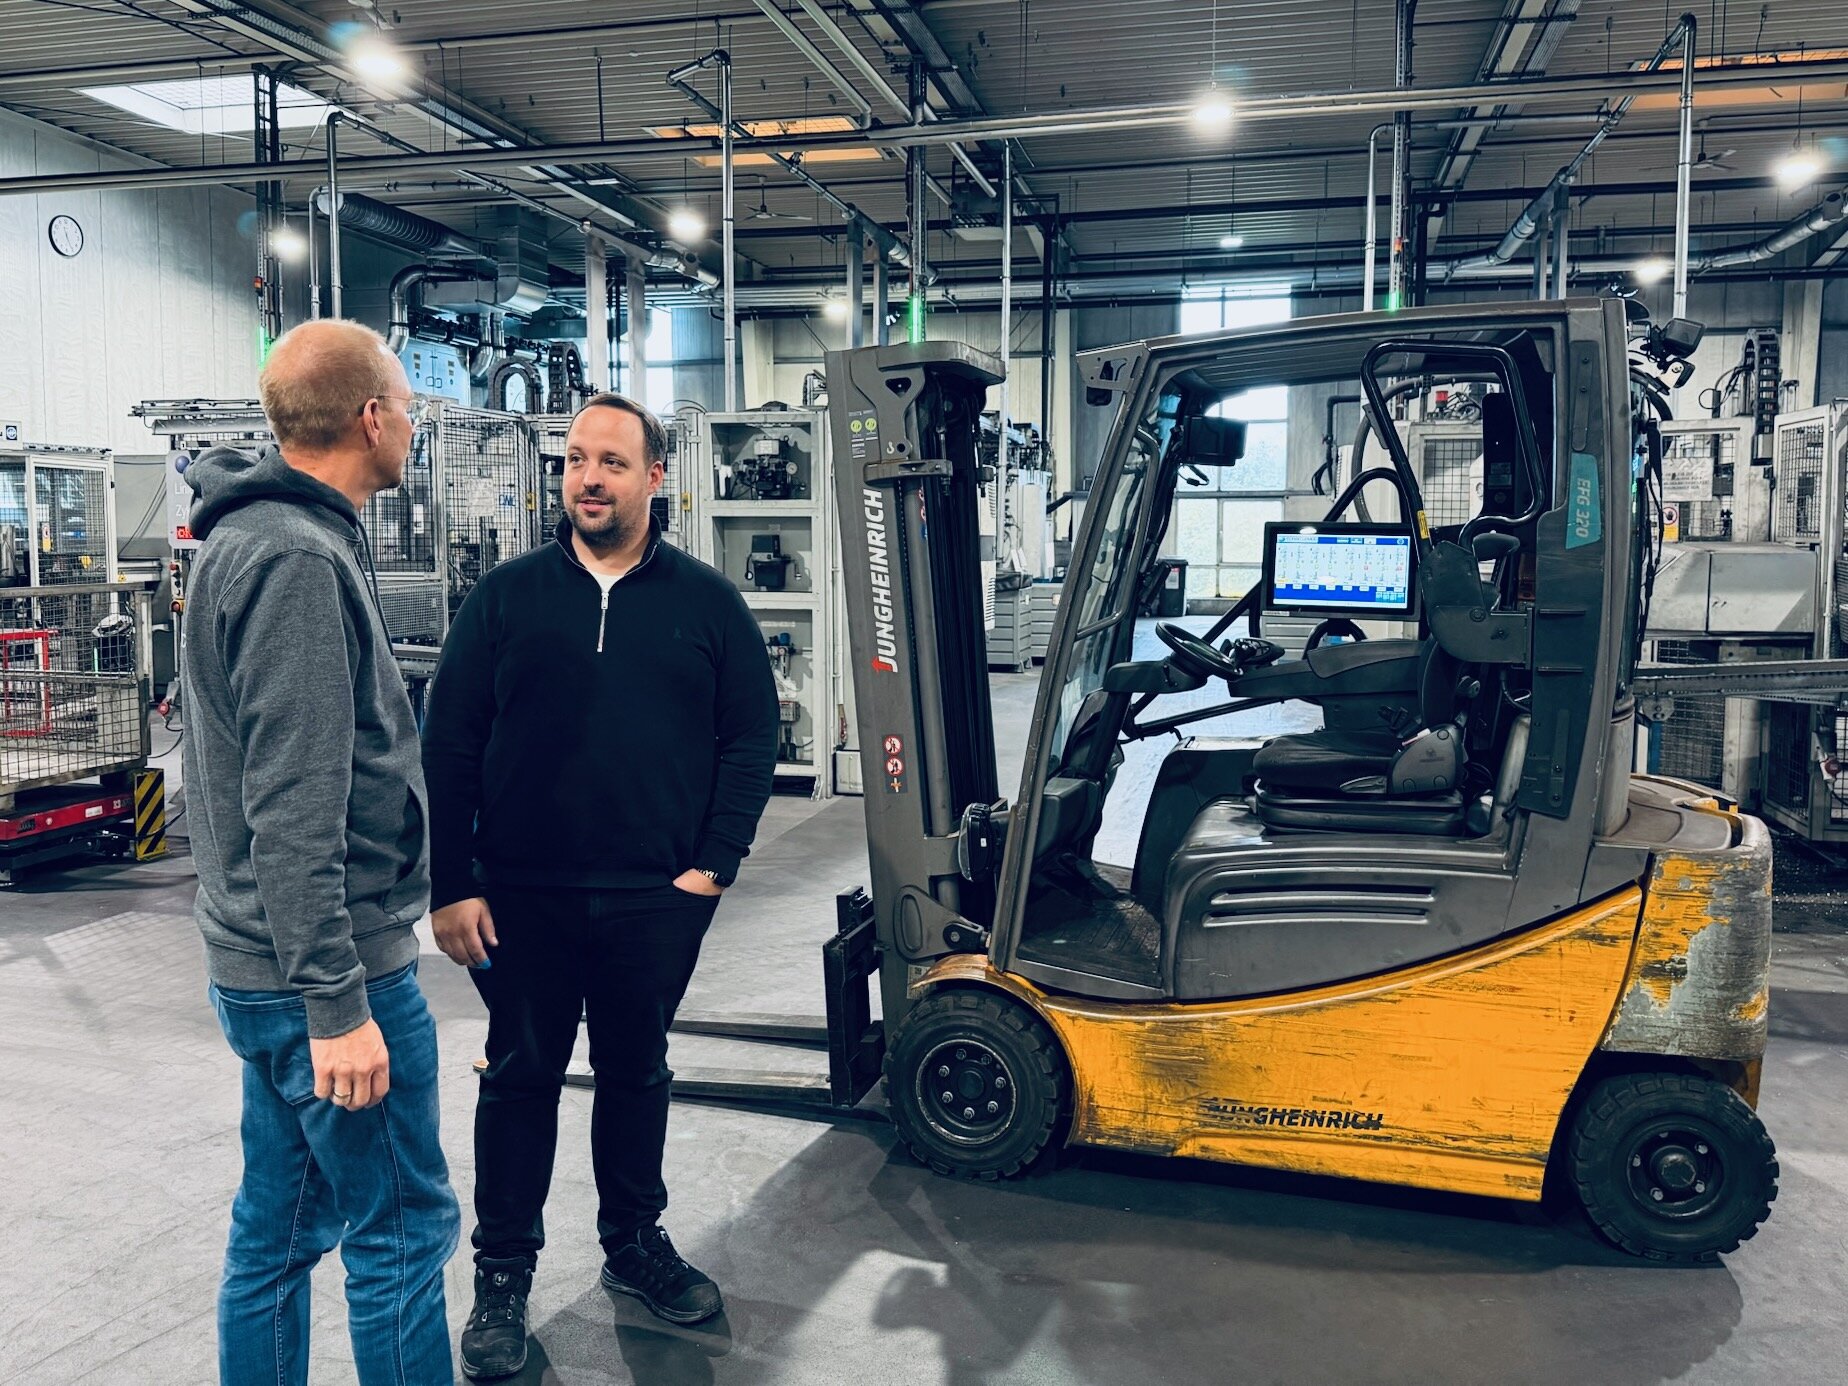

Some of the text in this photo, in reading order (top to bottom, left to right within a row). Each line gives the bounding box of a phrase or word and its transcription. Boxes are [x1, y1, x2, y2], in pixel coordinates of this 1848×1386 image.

[1575, 477, 1591, 538] EFG 320
[863, 489, 899, 673] JUNGHEINRICH
